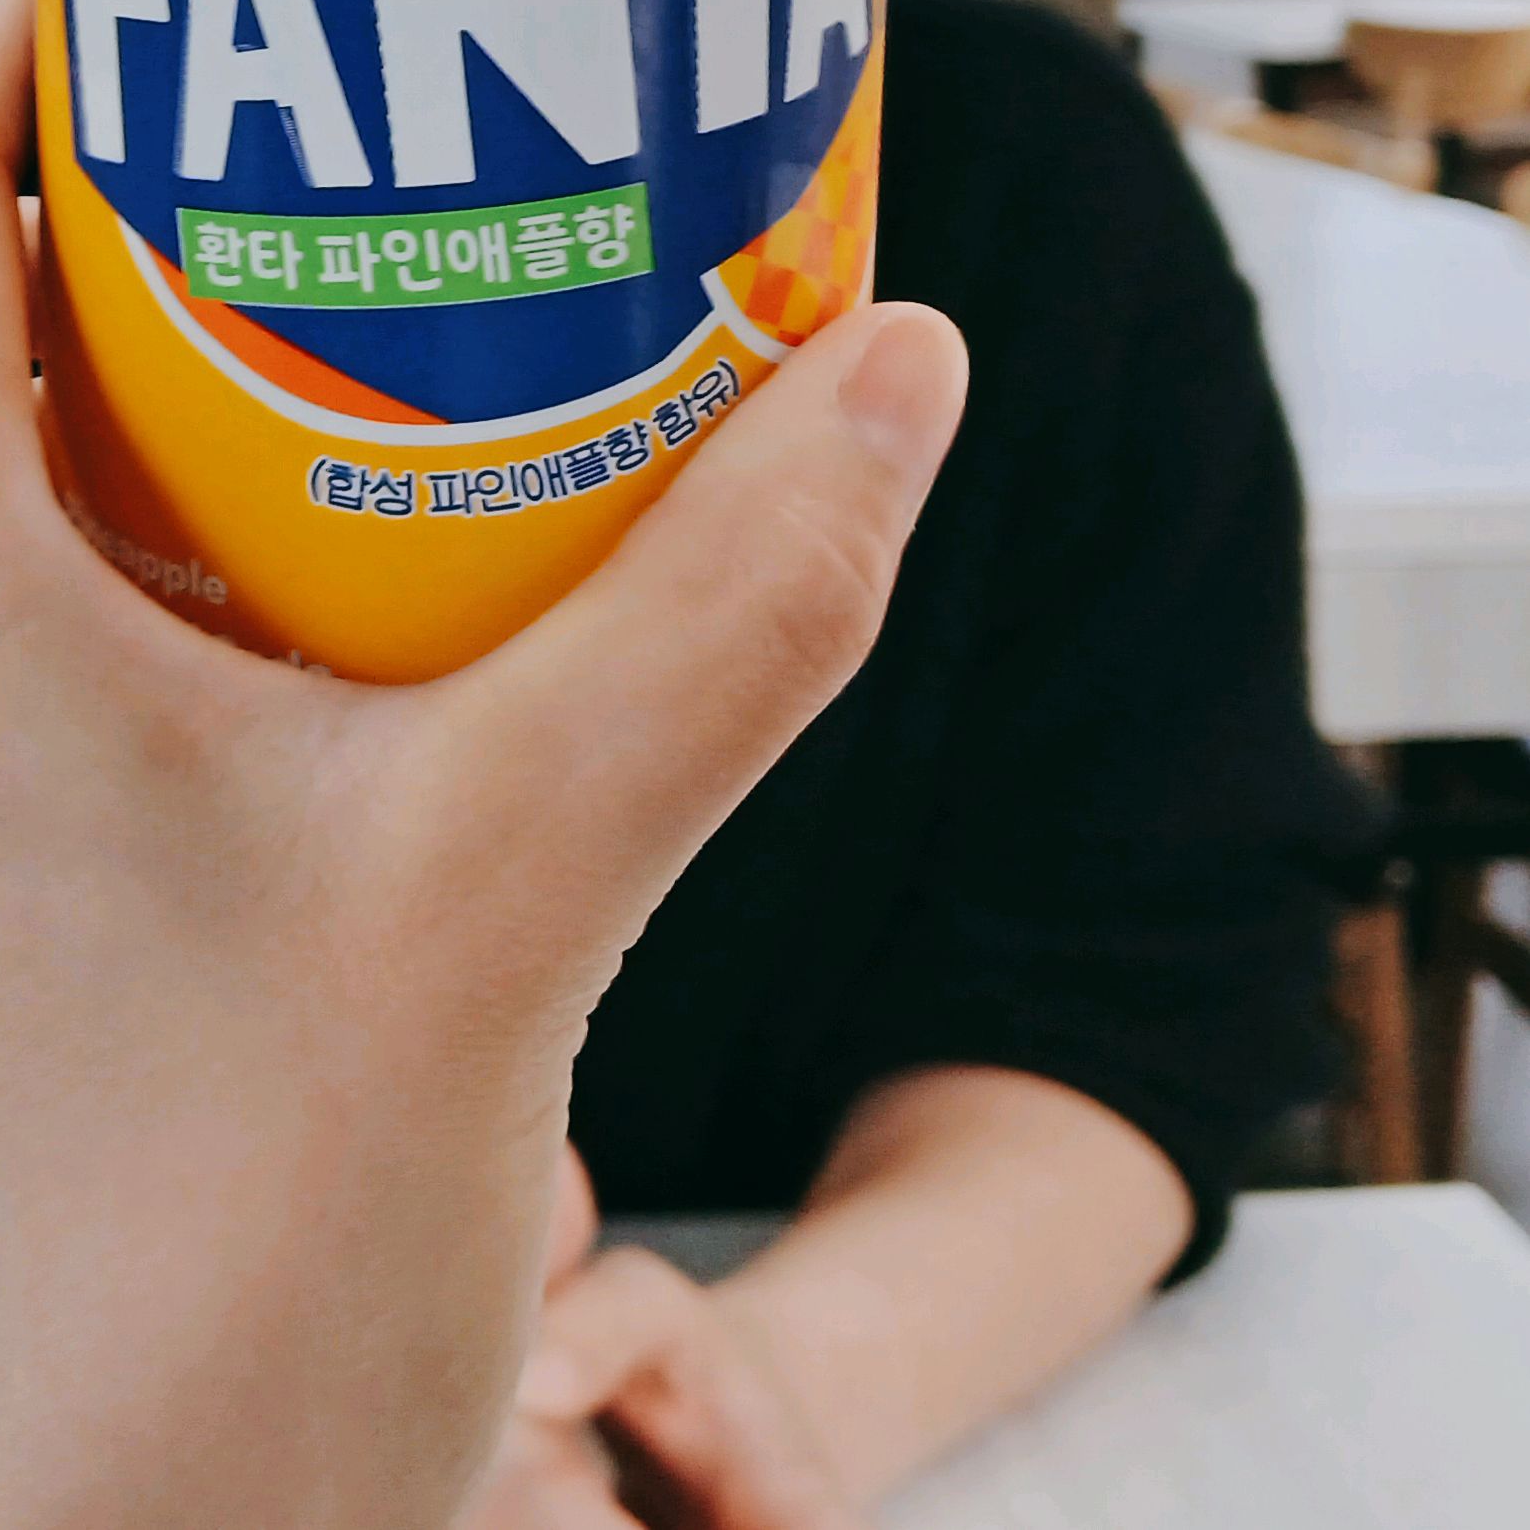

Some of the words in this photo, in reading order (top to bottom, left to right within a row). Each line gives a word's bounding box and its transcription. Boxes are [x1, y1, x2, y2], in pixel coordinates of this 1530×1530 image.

[193, 220, 304, 291] 환타
[314, 202, 636, 293] 파인애플향
[310, 458, 414, 516] (합성
[428, 421, 650, 514] 파인애플향
[652, 360, 740, 447] 함유)
